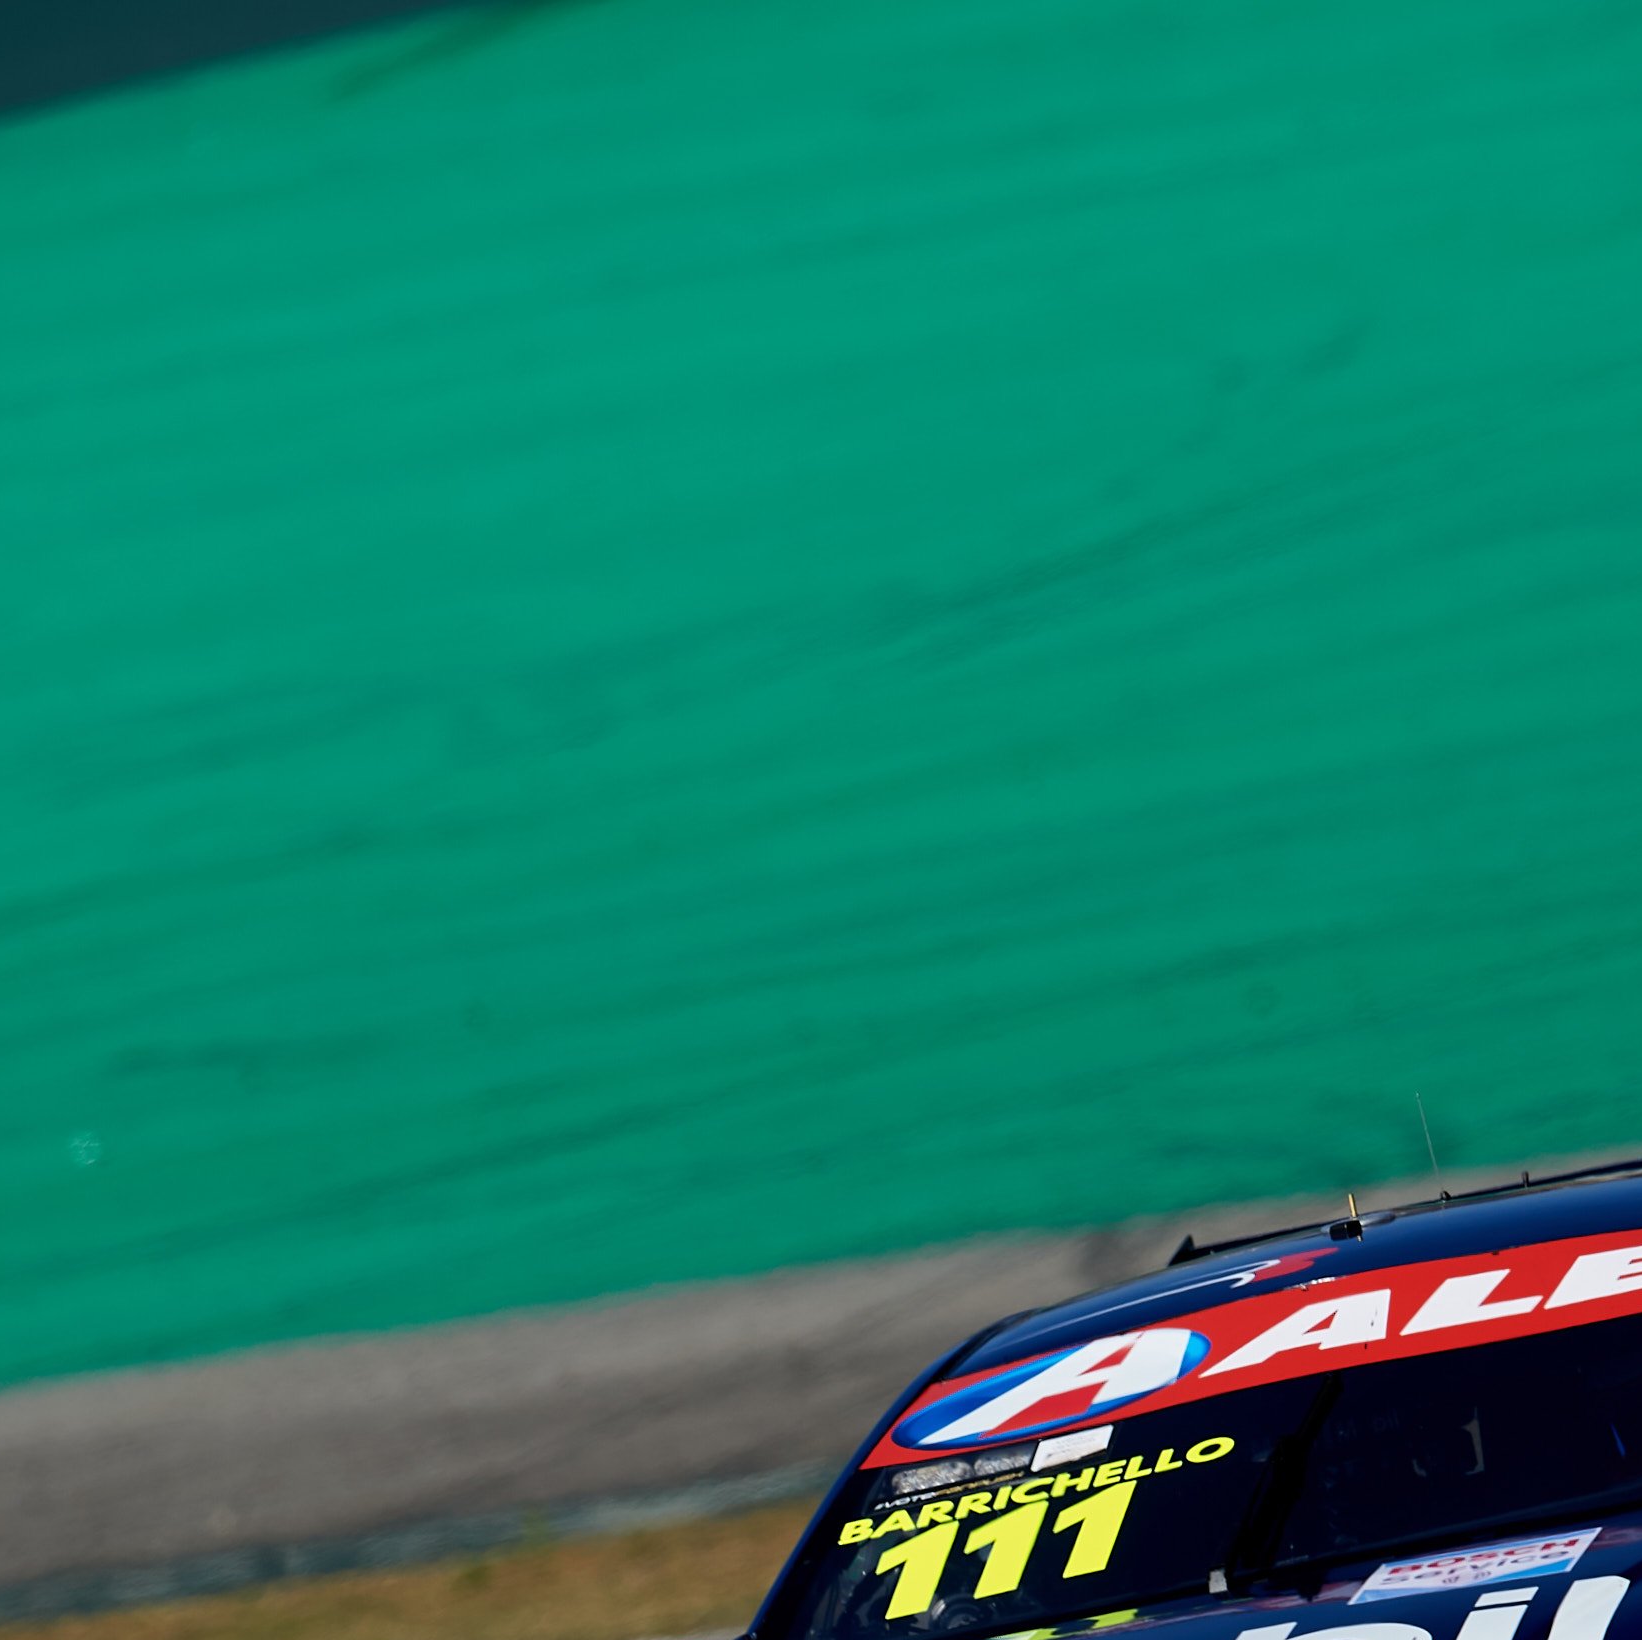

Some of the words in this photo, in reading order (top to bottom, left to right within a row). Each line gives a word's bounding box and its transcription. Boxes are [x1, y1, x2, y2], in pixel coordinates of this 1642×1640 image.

[836, 1436, 1236, 1546] BARRICHELLO
[875, 1483, 1136, 1621] 111
[1388, 1538, 1580, 1575] BOSCH
